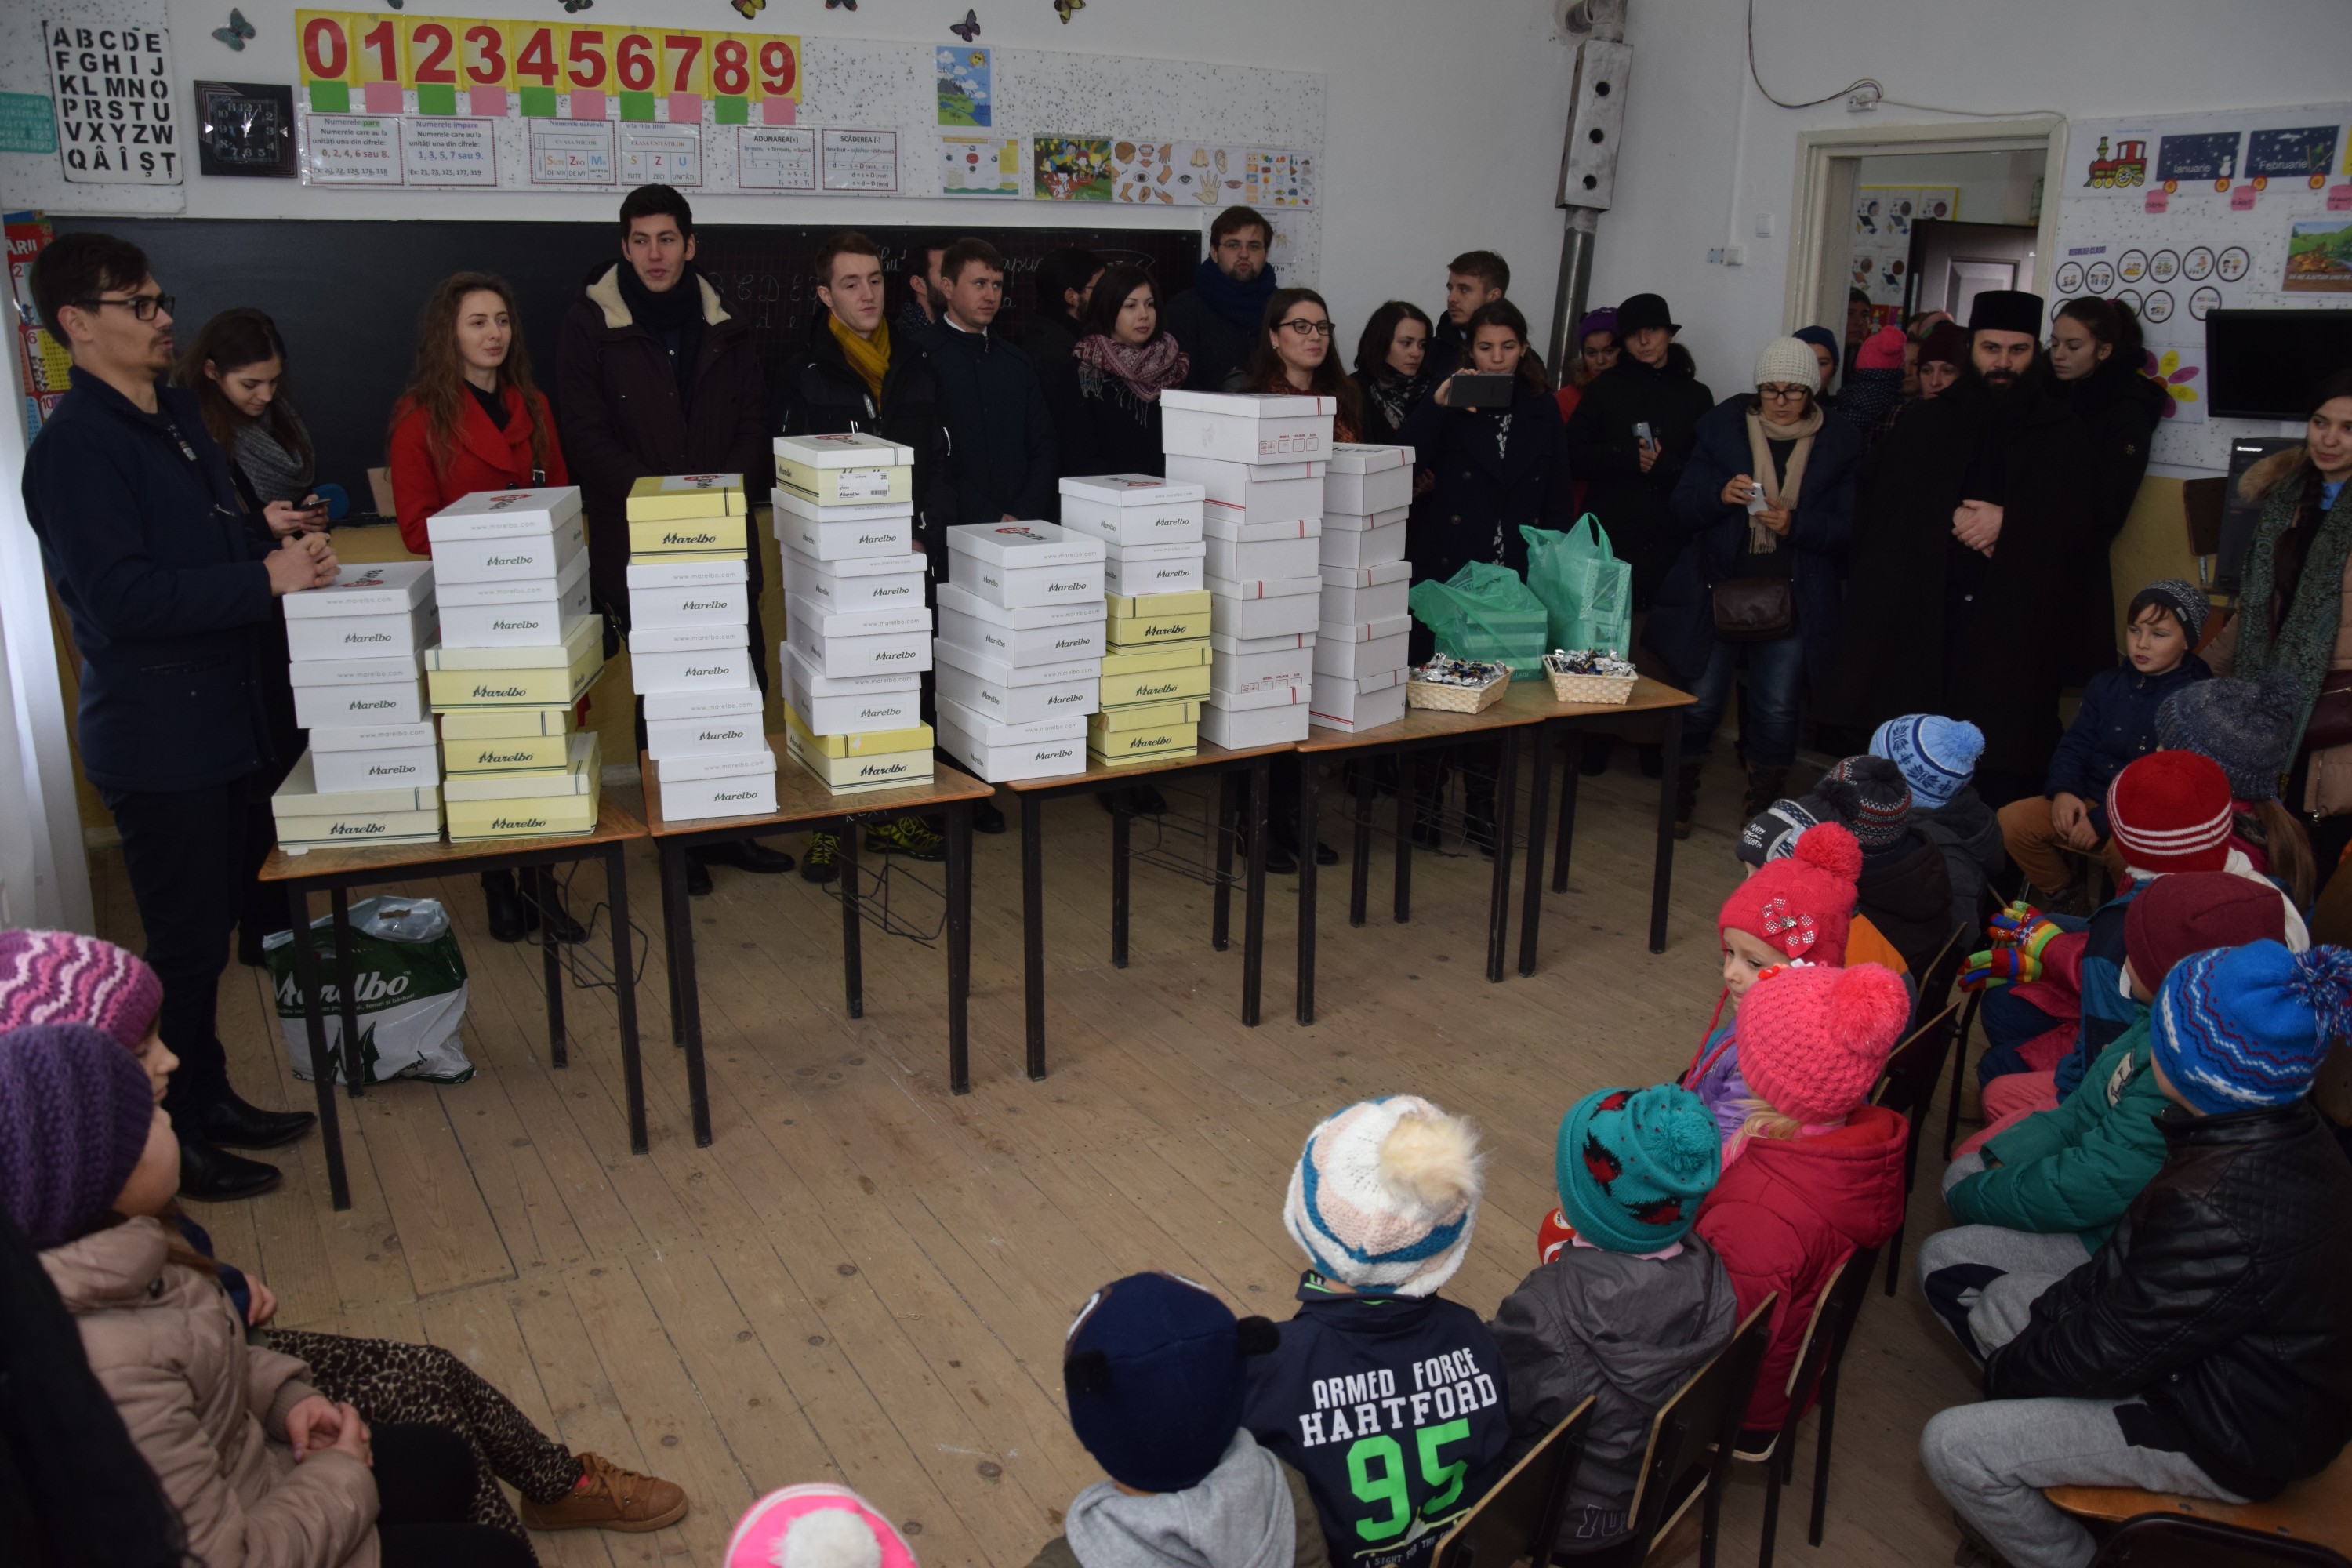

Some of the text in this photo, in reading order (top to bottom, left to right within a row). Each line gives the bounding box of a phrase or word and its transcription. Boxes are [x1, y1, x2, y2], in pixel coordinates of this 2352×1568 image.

[53, 27, 162, 53] A B C D E
[303, 18, 795, 96] 0 1 2 3 4 5 6 7 8 9
[56, 51, 164, 77] F G H I J
[59, 74, 169, 100] K L M N O
[63, 98, 78, 118] P
[85, 100, 103, 119] R
[107, 100, 124, 120] S
[129, 102, 145, 121] T
[153, 103, 170, 122] U
[64, 122, 82, 141] V
[87, 122, 107, 143] X
[110, 123, 127, 143] Y
[132, 124, 149, 143] Z
[151, 125, 173, 144] W
[67, 148, 88, 171] Q
[93, 145, 111, 170] Â
[119, 146, 128, 171] Î
[333, 149, 341, 158] 2,
[343, 149, 353, 158] 4,
[428, 151, 437, 160] 3,
[439, 151, 448, 160] 5,
[450, 151, 456, 160] 7
[630, 155, 687, 166] S Z U
[2259, 160, 2308, 171] Februarie
[2174, 163, 2211, 174] Ianuarie
[27, 332, 38, 345] 6
[41, 397, 54, 409] 10
[662, 533, 716, 544] Marelbo
[859, 535, 896, 544] Marelbo
[1043, 551, 1097, 560] www.marelbo.com
[487, 556, 533, 566] Marelbo
[873, 587, 909, 597] Marelbo
[1048, 583, 1087, 592] Marelbo
[683, 601, 728, 610] Marelbo
[1051, 609, 1100, 619] www.marelbo.com
[493, 620, 539, 630] Marelbo
[862, 618, 920, 627] www.marelbo.com
[1145, 625, 1188, 638] Marelbo
[344, 633, 392, 643] Marelbo
[673, 633, 736, 641] www.marelbo.com
[1055, 638, 1091, 648] Marelbo
[876, 651, 916, 661] Marelbo
[685, 667, 729, 677] Marelbo
[1043, 667, 1093, 677] www.marelbo.com
[855, 675, 912, 685] www.marelbo.com
[473, 686, 526, 697] Marelbo
[1136, 684, 1179, 697] Marelbo
[350, 700, 397, 710] Marelbo
[1048, 695, 1083, 705] Marelbo
[691, 702, 753, 711] www.marelbo.com
[860, 708, 901, 717] Marelbo
[1025, 723, 1077, 733] www.marelbo.com
[359, 729, 425, 739] www.marelbo.com
[699, 731, 743, 741] Marelbo
[1130, 736, 1174, 749] Marelbo
[478, 752, 533, 763] Marelbo
[1035, 750, 1073, 760] Marelbo
[368, 765, 416, 775] Marelbo
[704, 760, 765, 771] www.marelbo.com
[860, 764, 909, 778] Marelbo
[714, 792, 757, 801] Marelbo
[492, 818, 546, 829] Marelbo
[330, 823, 387, 836] Marelbo
[1312, 1347, 1480, 1410] ARMED FORCE
[1299, 1374, 1497, 1447] HARTFORD
[1347, 1417, 1471, 1541] 95
[1374, 1555, 1403, 1566] SIGHT
